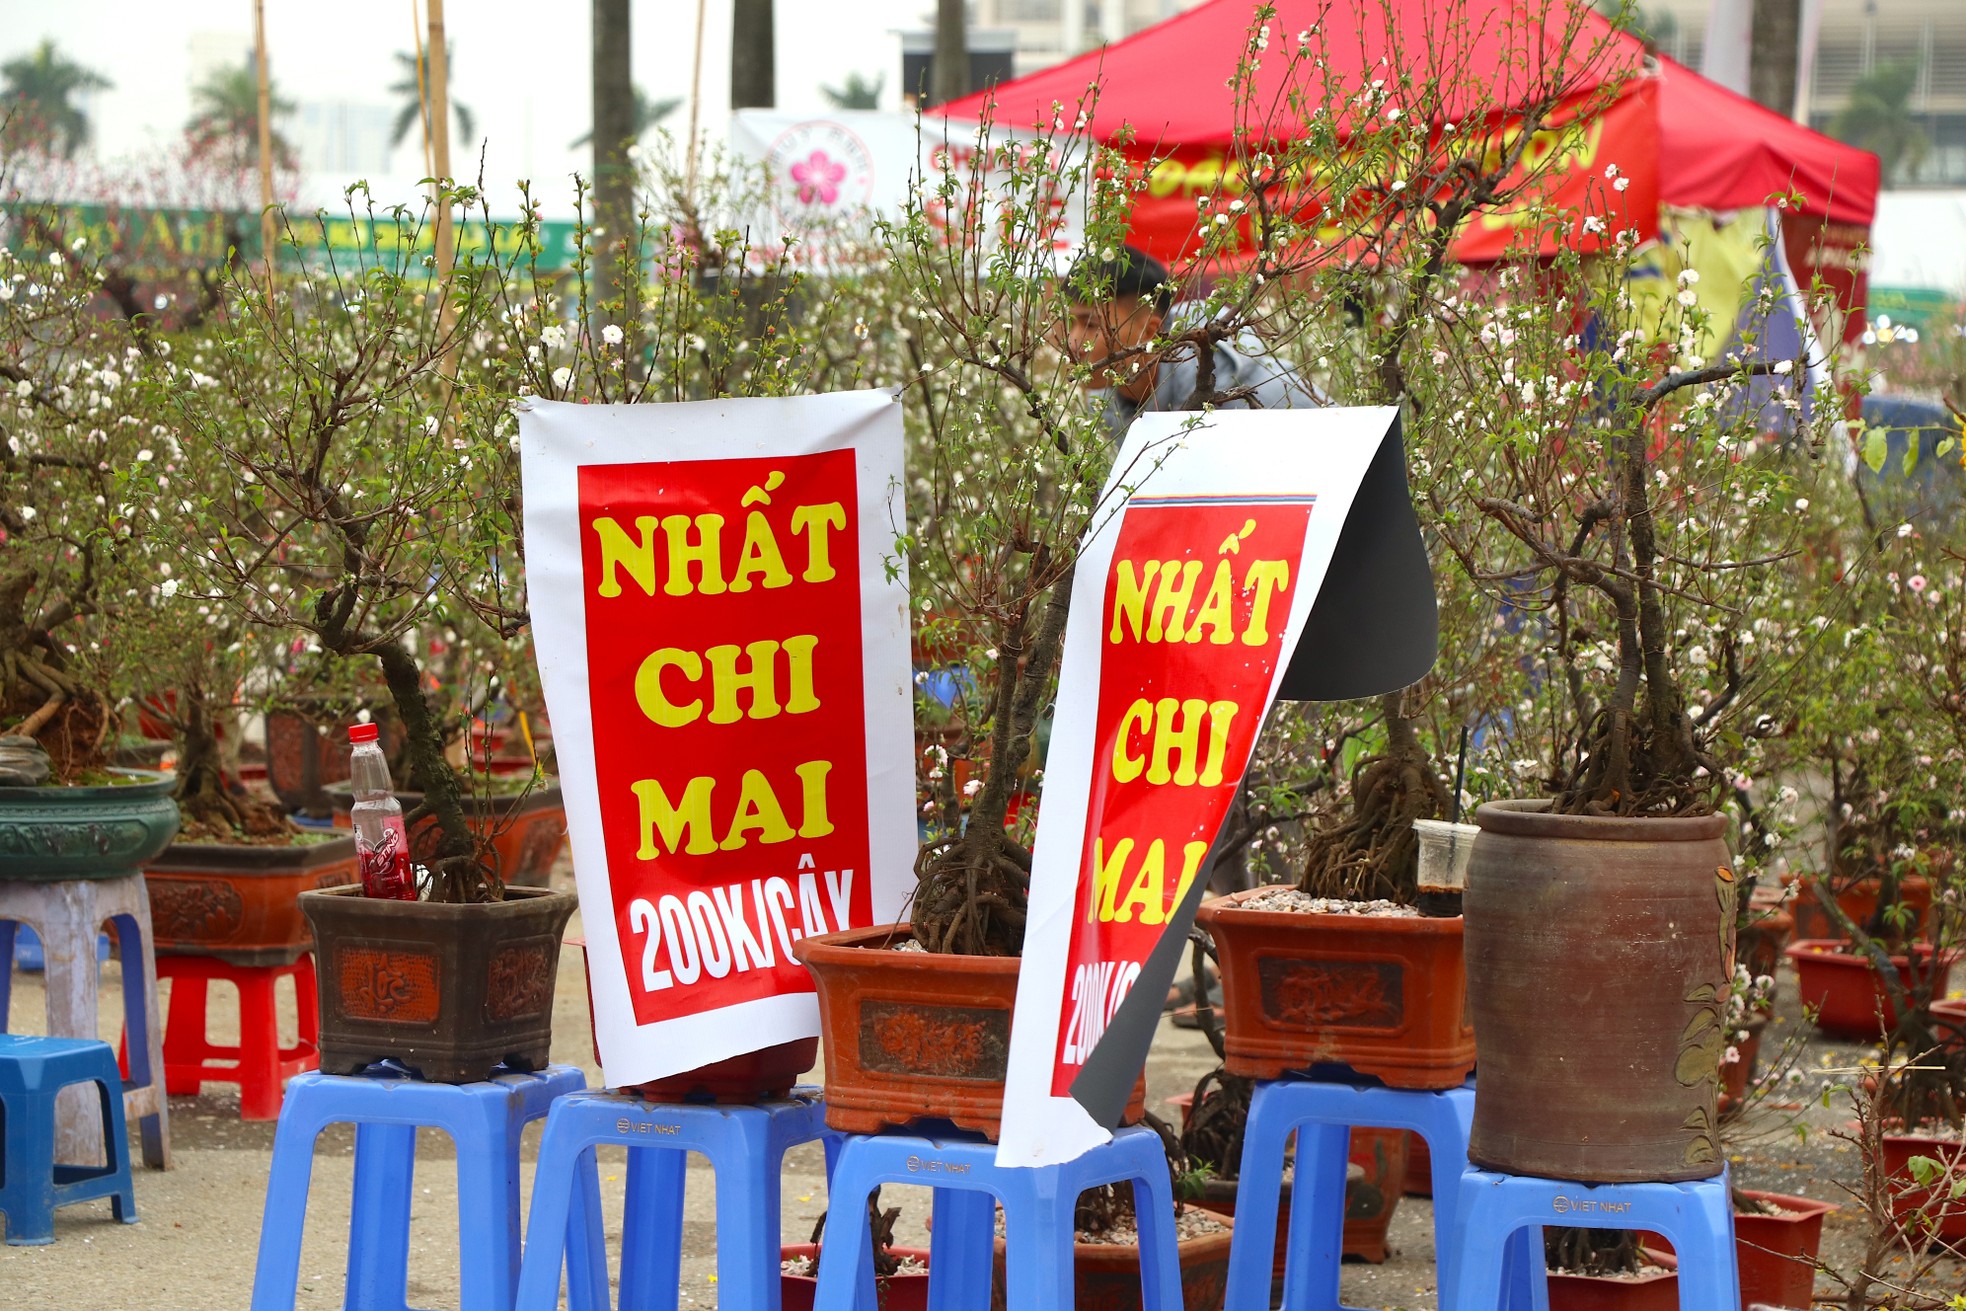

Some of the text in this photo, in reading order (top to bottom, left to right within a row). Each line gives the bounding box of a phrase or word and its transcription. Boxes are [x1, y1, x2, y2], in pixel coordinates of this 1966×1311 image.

[592, 470, 847, 598] NHẤT
[1109, 518, 1289, 646] NHẤT
[634, 634, 821, 728] CHI
[1112, 697, 1239, 787] CHI
[630, 760, 835, 861] MAI
[629, 853, 854, 993] 200K/CÂY
[1087, 837, 1208, 925] MAI
